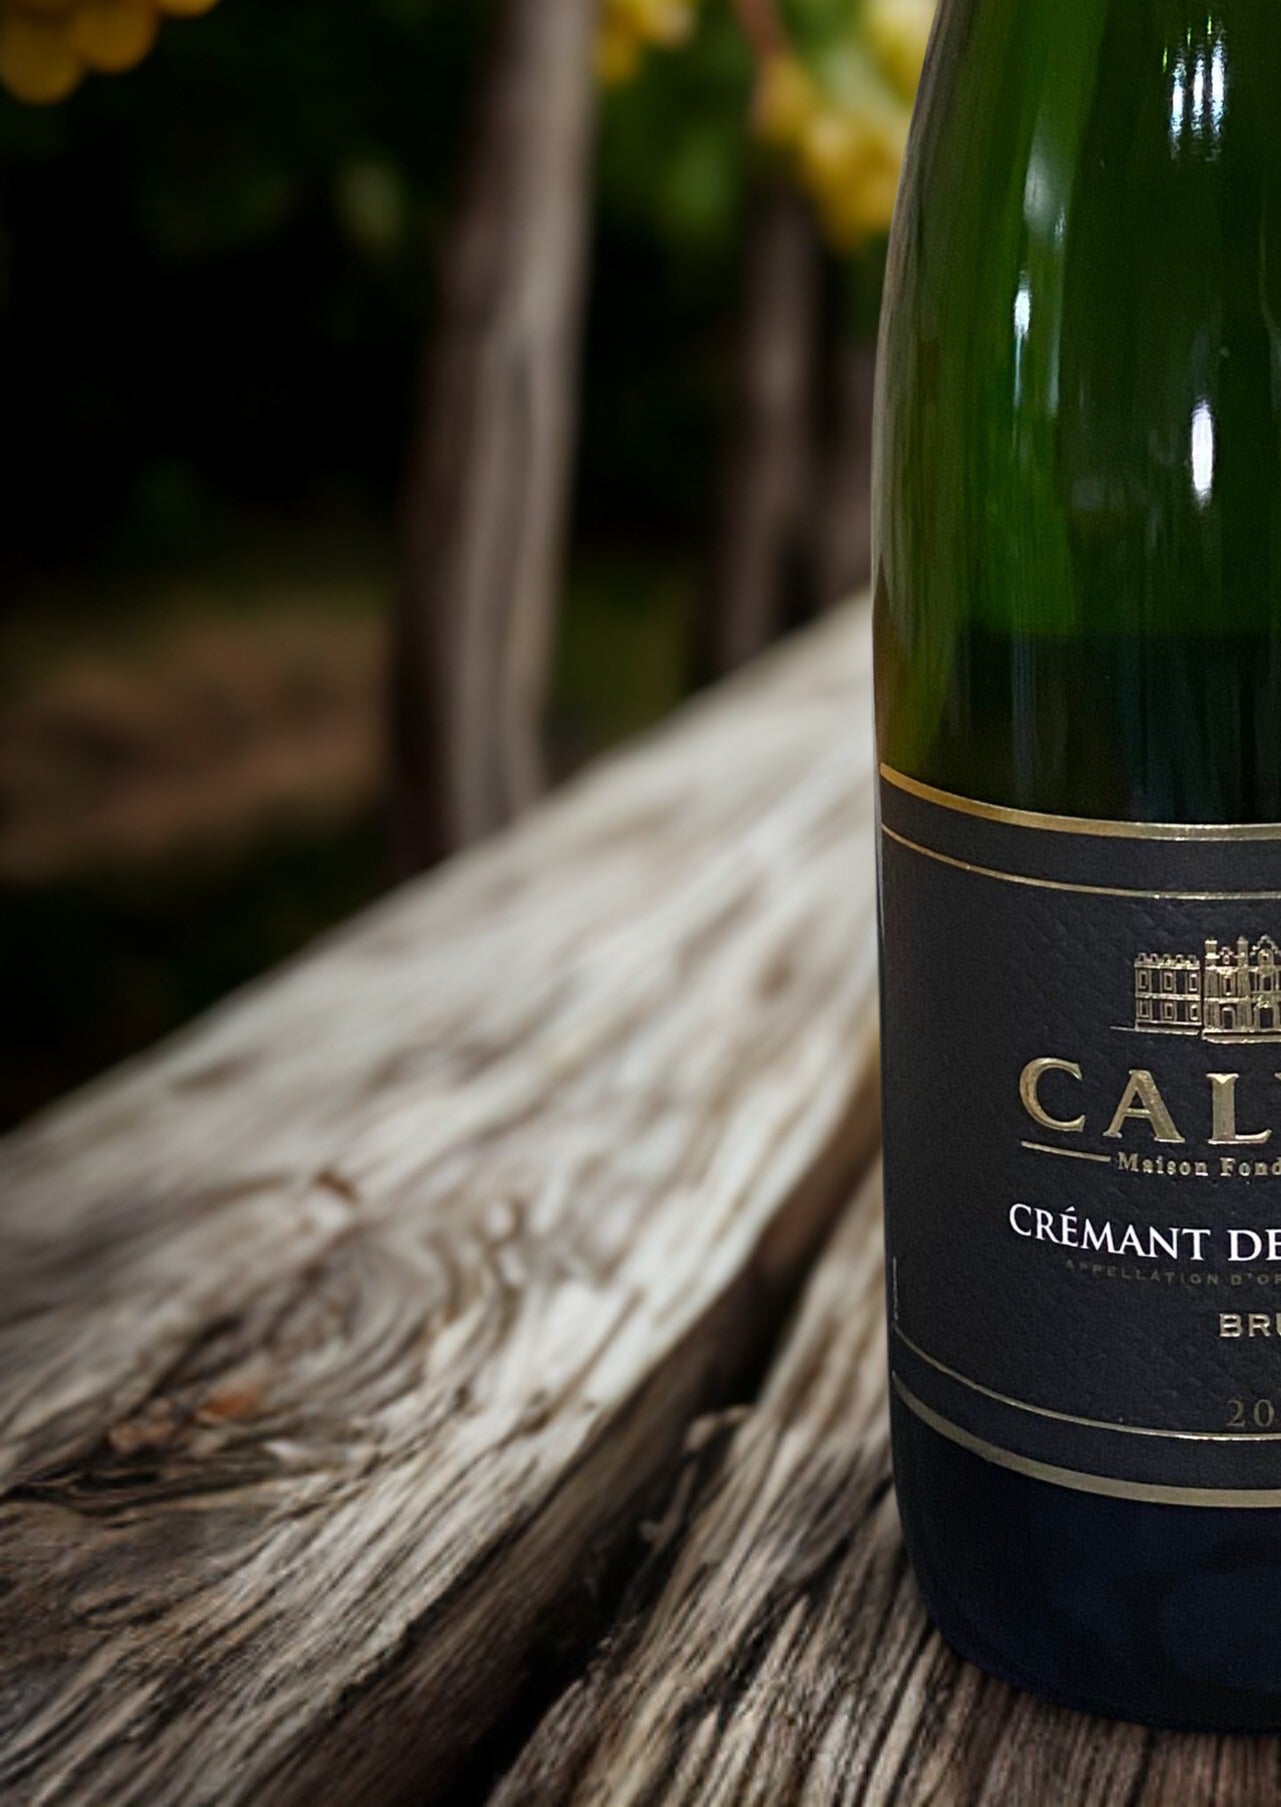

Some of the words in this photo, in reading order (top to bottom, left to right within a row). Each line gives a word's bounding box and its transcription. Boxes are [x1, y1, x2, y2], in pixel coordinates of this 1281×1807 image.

[1117, 1152, 1209, 1176] Maison
[1009, 1203, 1211, 1261] CRÉMANT
[1066, 1259, 1219, 1286] APPELLATION
